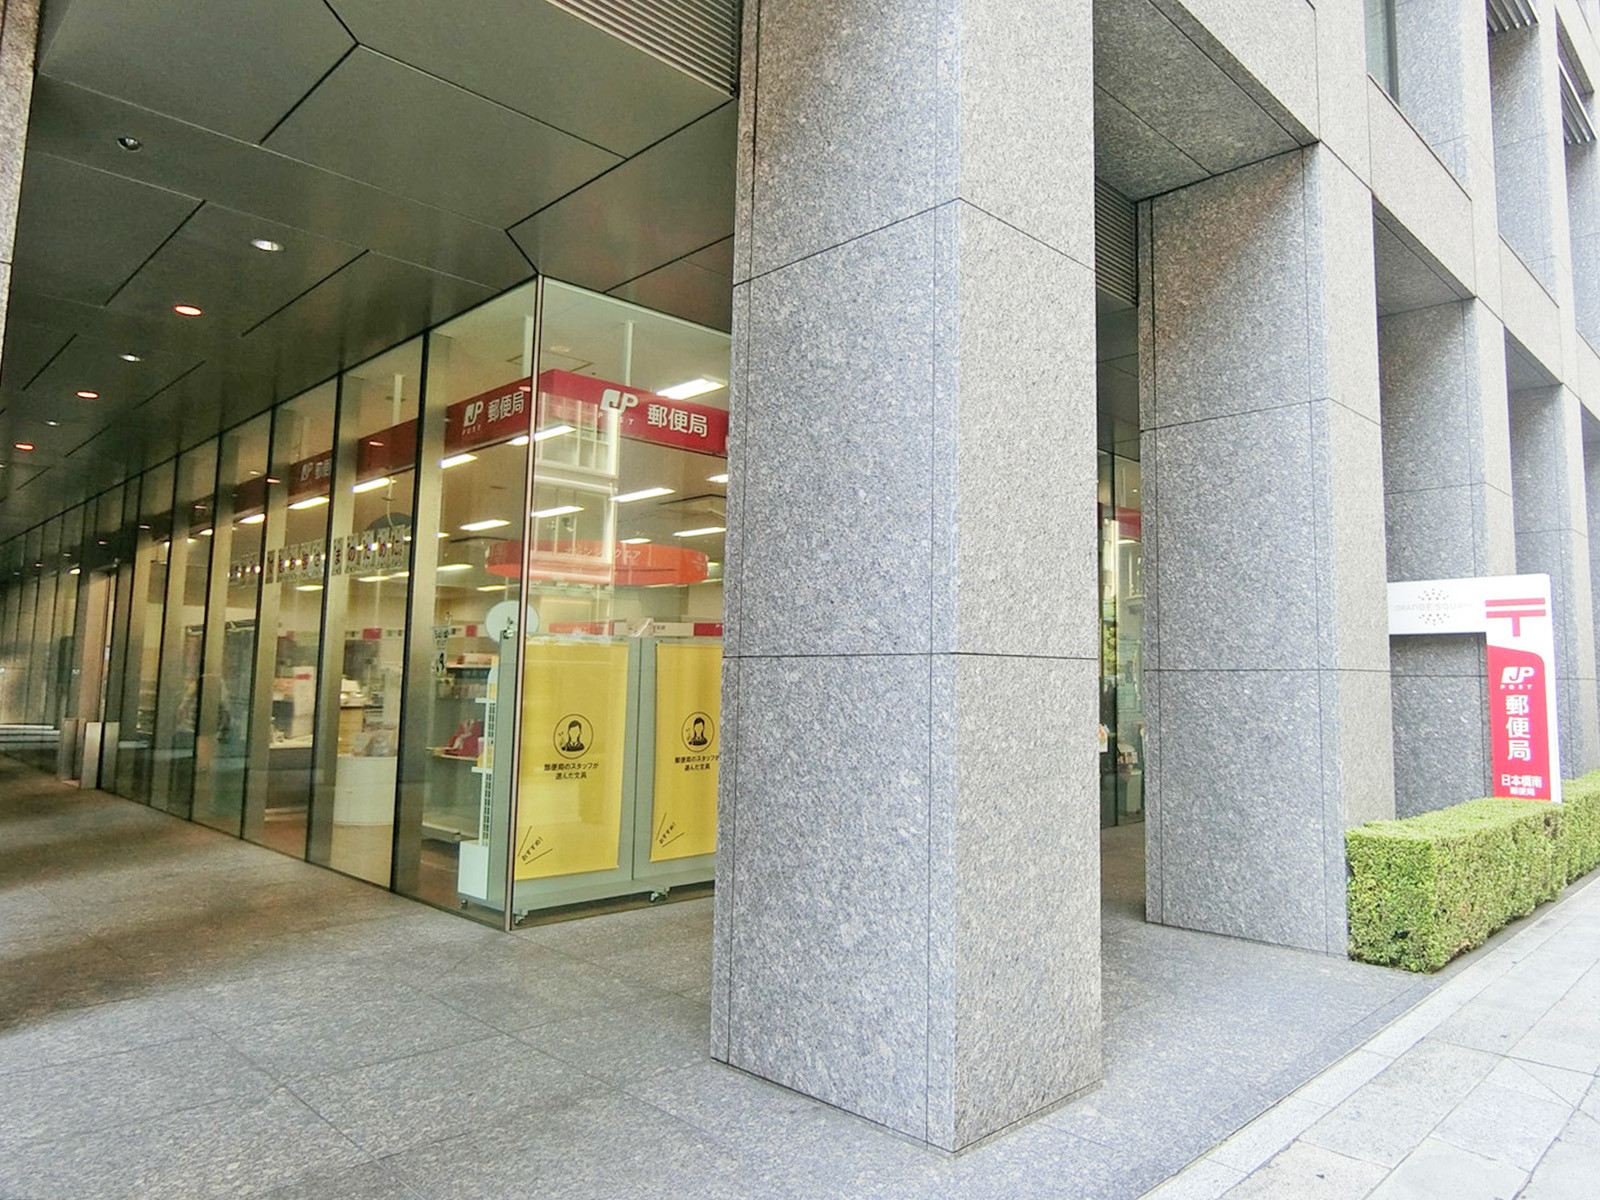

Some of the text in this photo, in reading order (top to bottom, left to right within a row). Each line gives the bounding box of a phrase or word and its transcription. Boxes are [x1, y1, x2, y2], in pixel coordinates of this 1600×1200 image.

[487, 391, 524, 423] 郵便局
[597, 411, 635, 425] PST
[647, 403, 708, 437] 郵便局
[1505, 694, 1532, 762] 郵便局
[1501, 774, 1543, 789] 日本橋南
